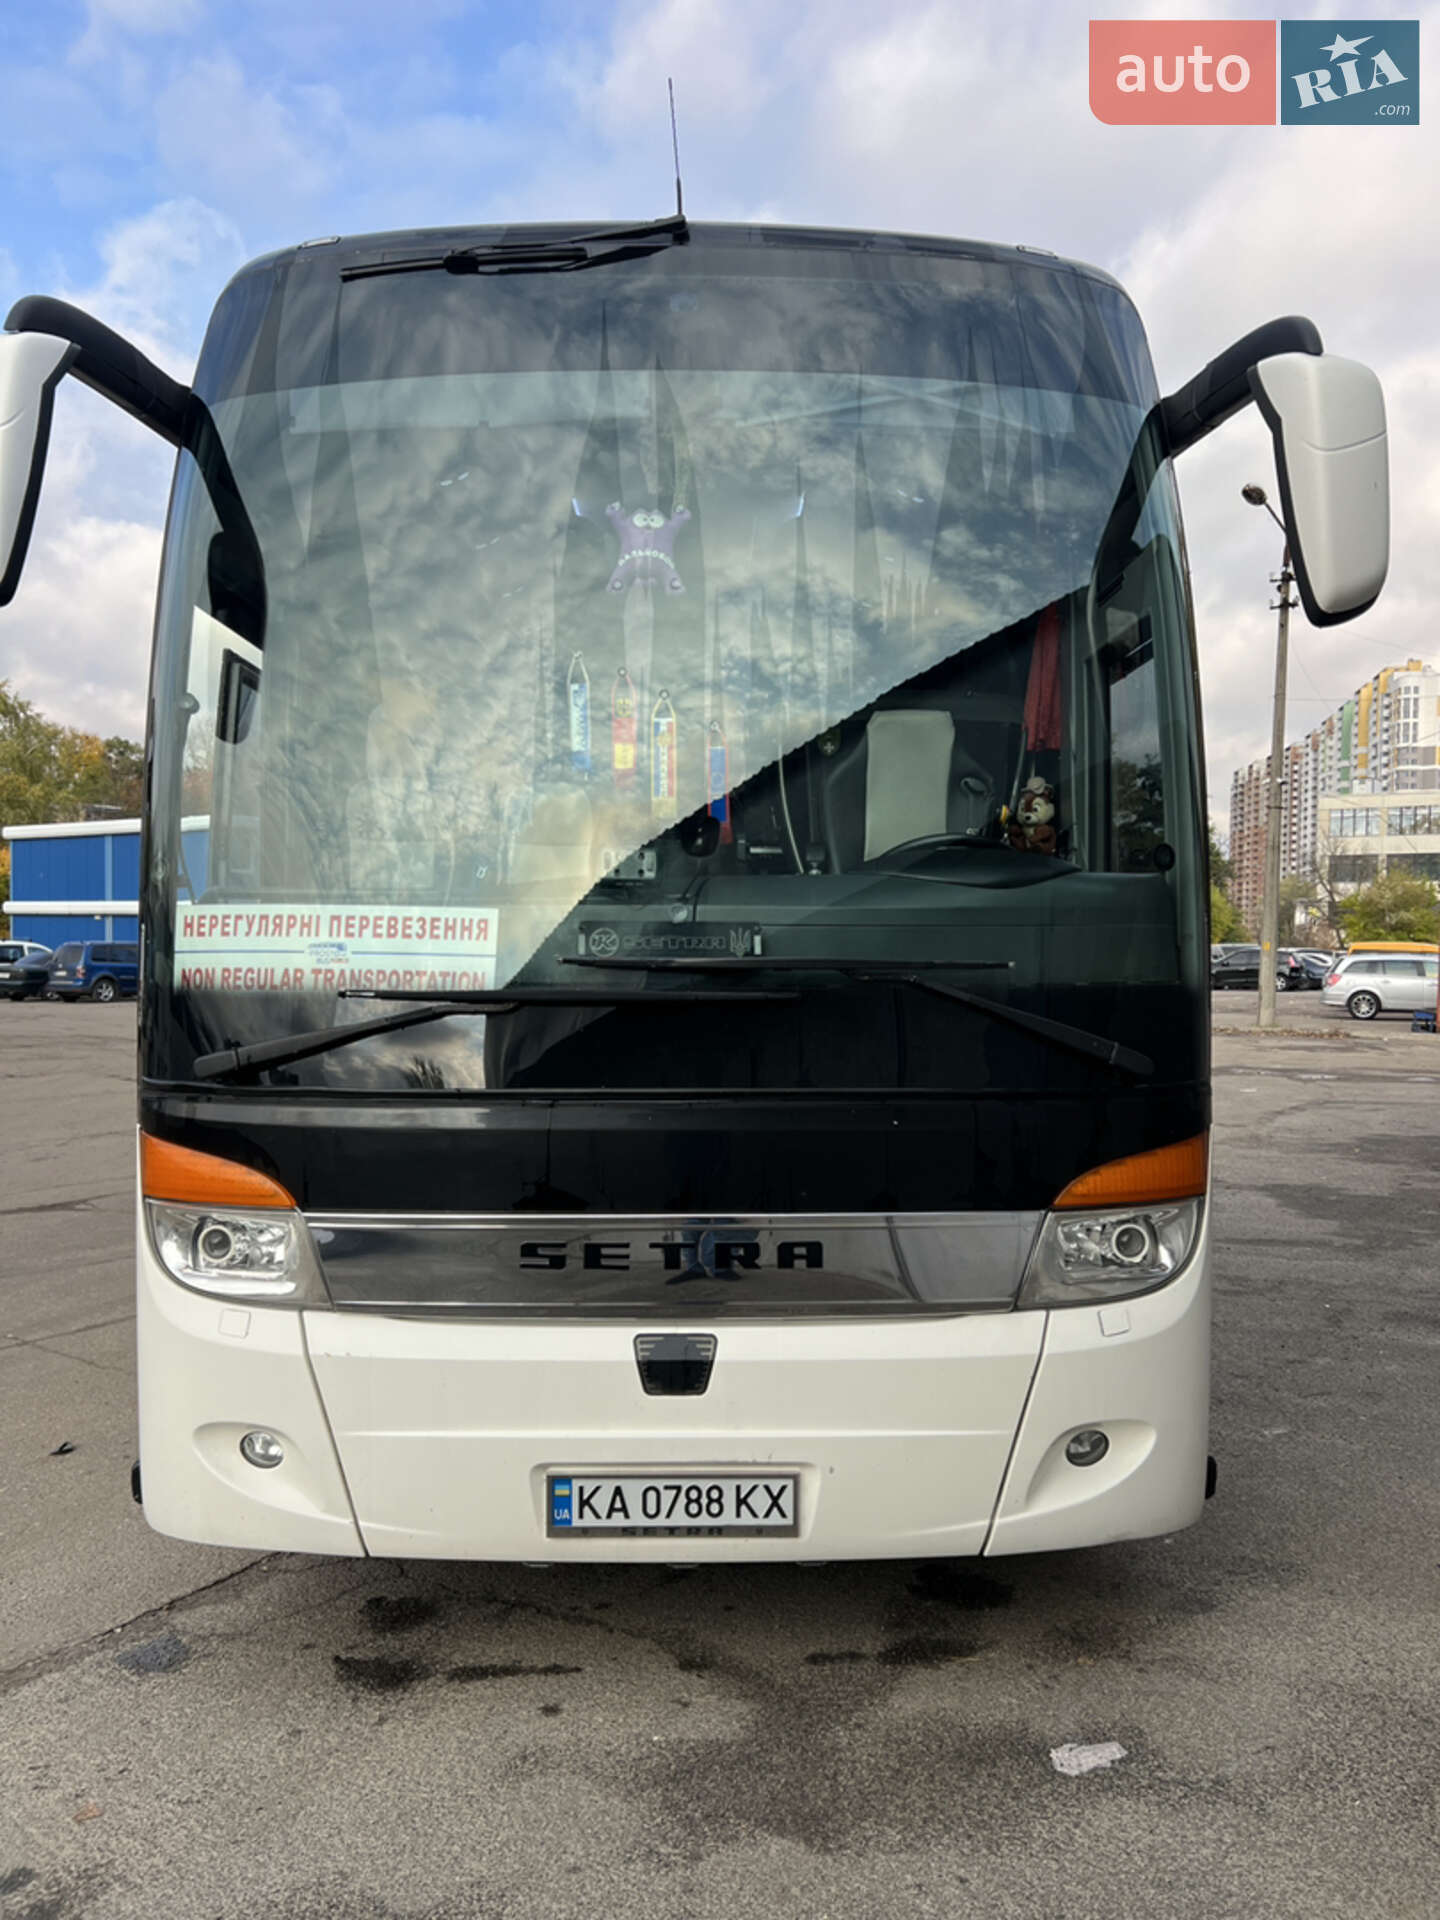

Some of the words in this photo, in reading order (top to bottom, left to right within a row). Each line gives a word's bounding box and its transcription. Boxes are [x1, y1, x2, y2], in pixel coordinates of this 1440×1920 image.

[183, 914, 321, 938] НЕРЕГУЛЯРНІ
[328, 914, 489, 941] ПЕРЕВЕЗЕННЯ
[181, 967, 215, 991] NON
[220, 967, 305, 991] REGULAR
[311, 968, 486, 991] TRANSPORTATION
[519, 1241, 823, 1270] SETRA
[554, 1509, 570, 1520] UA
[578, 1485, 630, 1520] KA
[641, 1485, 724, 1519] 0788
[735, 1484, 788, 1519] KX
[621, 1527, 723, 1536] SETRA
